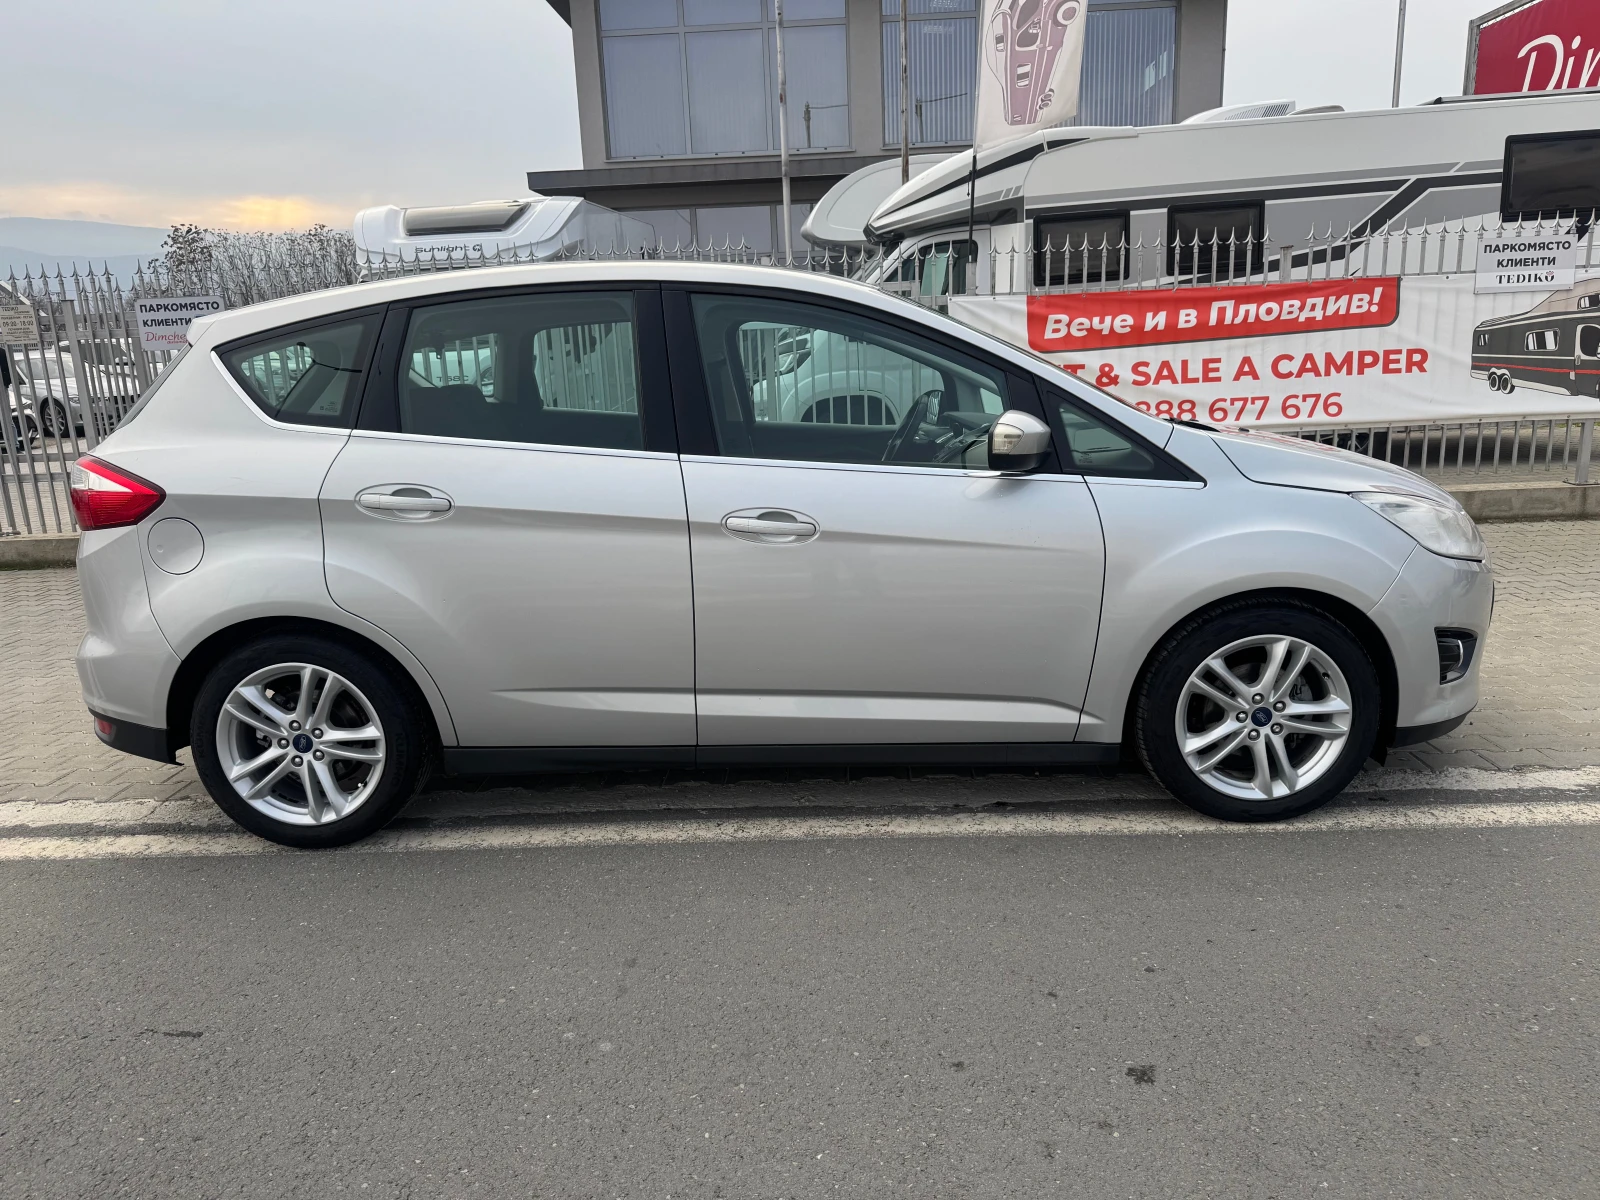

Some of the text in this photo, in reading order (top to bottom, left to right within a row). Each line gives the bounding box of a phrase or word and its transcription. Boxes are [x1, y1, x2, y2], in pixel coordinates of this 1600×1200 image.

[415, 244, 470, 254] Sunlight
[1483, 240, 1572, 254] ПАРКОМЯСТО
[1496, 256, 1556, 268] КЛИЕНТИ
[1495, 271, 1555, 284] TEDIKO
[139, 301, 220, 314] ПАРКОМЯСТО
[1044, 286, 1383, 340] Вече и в Пловдив!
[142, 317, 192, 328] КЛИЕНТИ
[144, 331, 187, 342] Dimche
[1095, 363, 1120, 388] &
[1131, 358, 1222, 387] SALE
[1232, 356, 1260, 381] A
[1270, 348, 1429, 380] CAMPER
[1208, 396, 1270, 423] 677
[1280, 392, 1343, 419] 676
